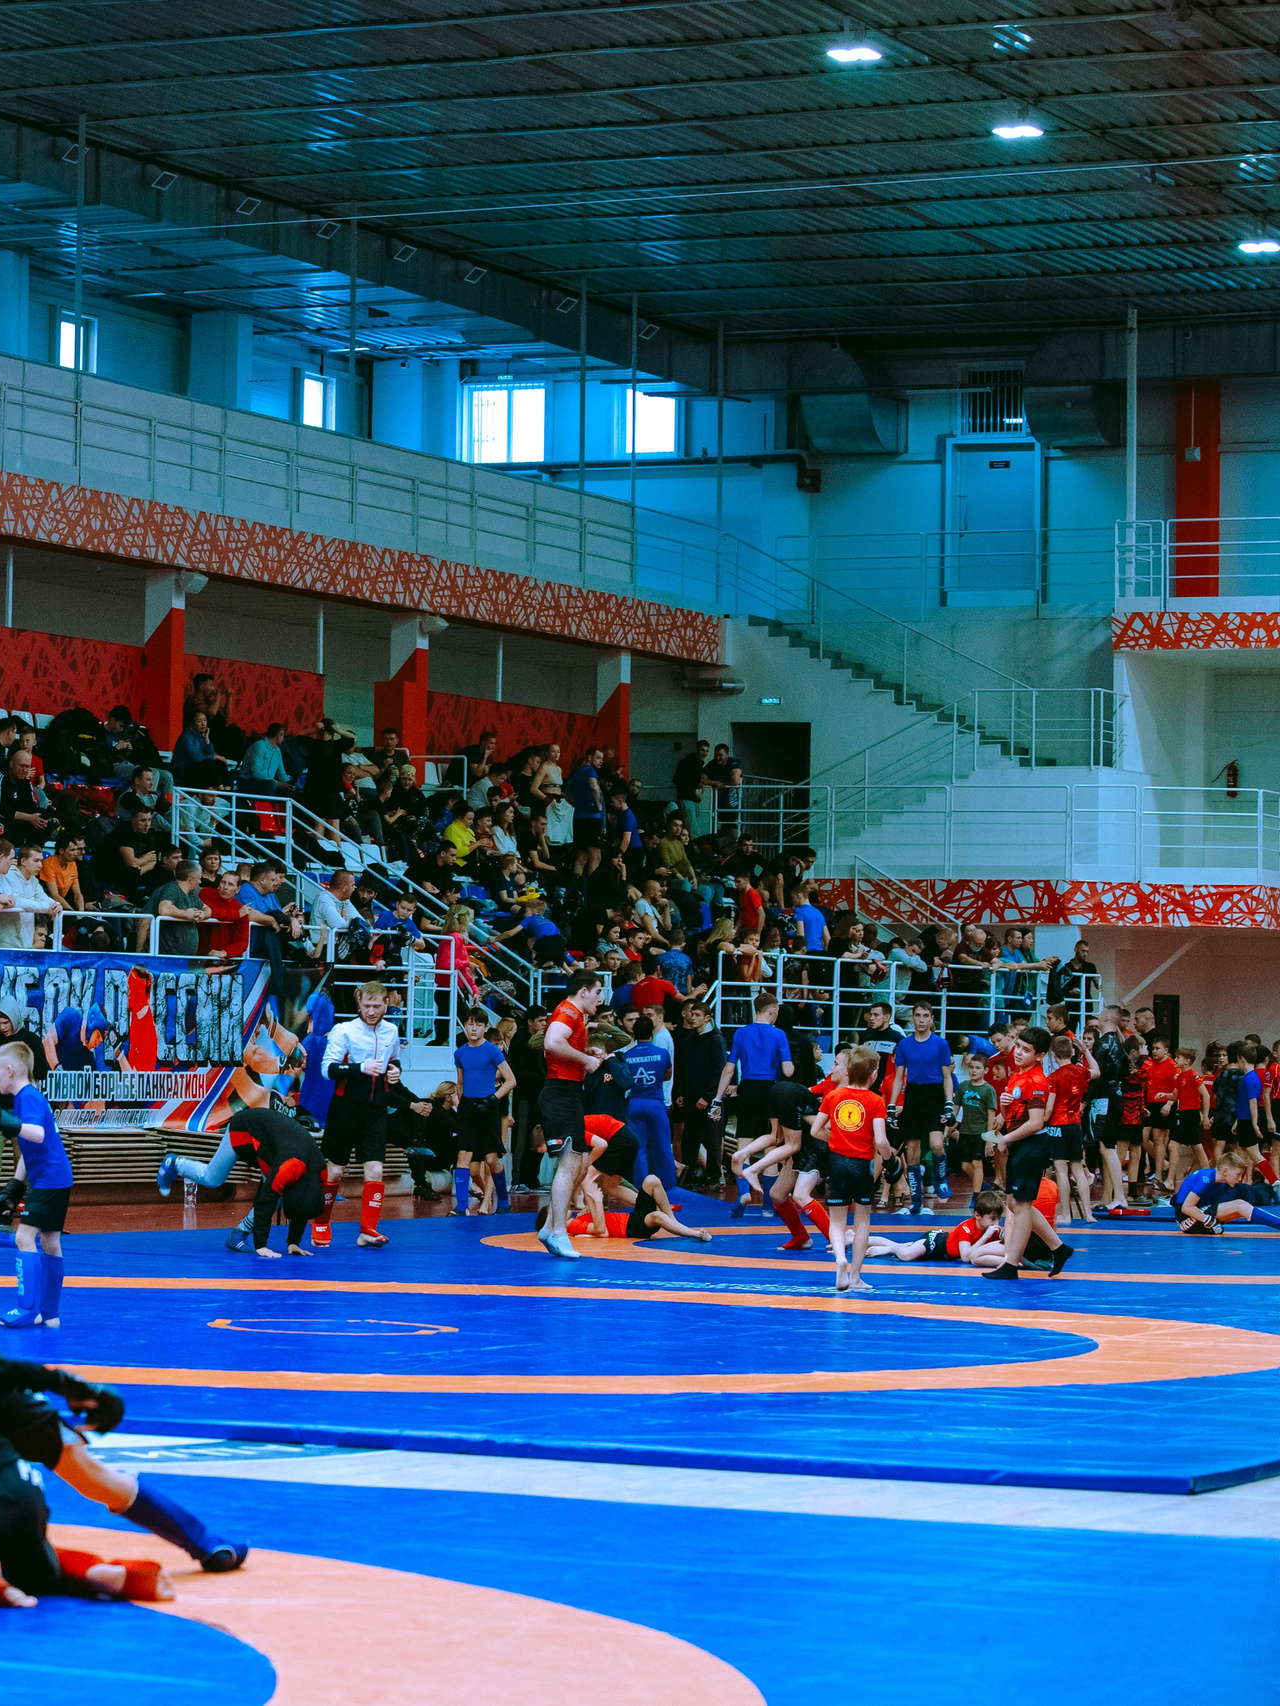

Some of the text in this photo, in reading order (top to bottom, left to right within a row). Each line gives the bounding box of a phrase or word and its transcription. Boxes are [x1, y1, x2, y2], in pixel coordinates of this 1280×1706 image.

[104, 969, 243, 1067] РССИИ
[92, 1071, 137, 1101] БОРЬБЕ
[137, 1071, 206, 1101] ПАНКРАТИОН
